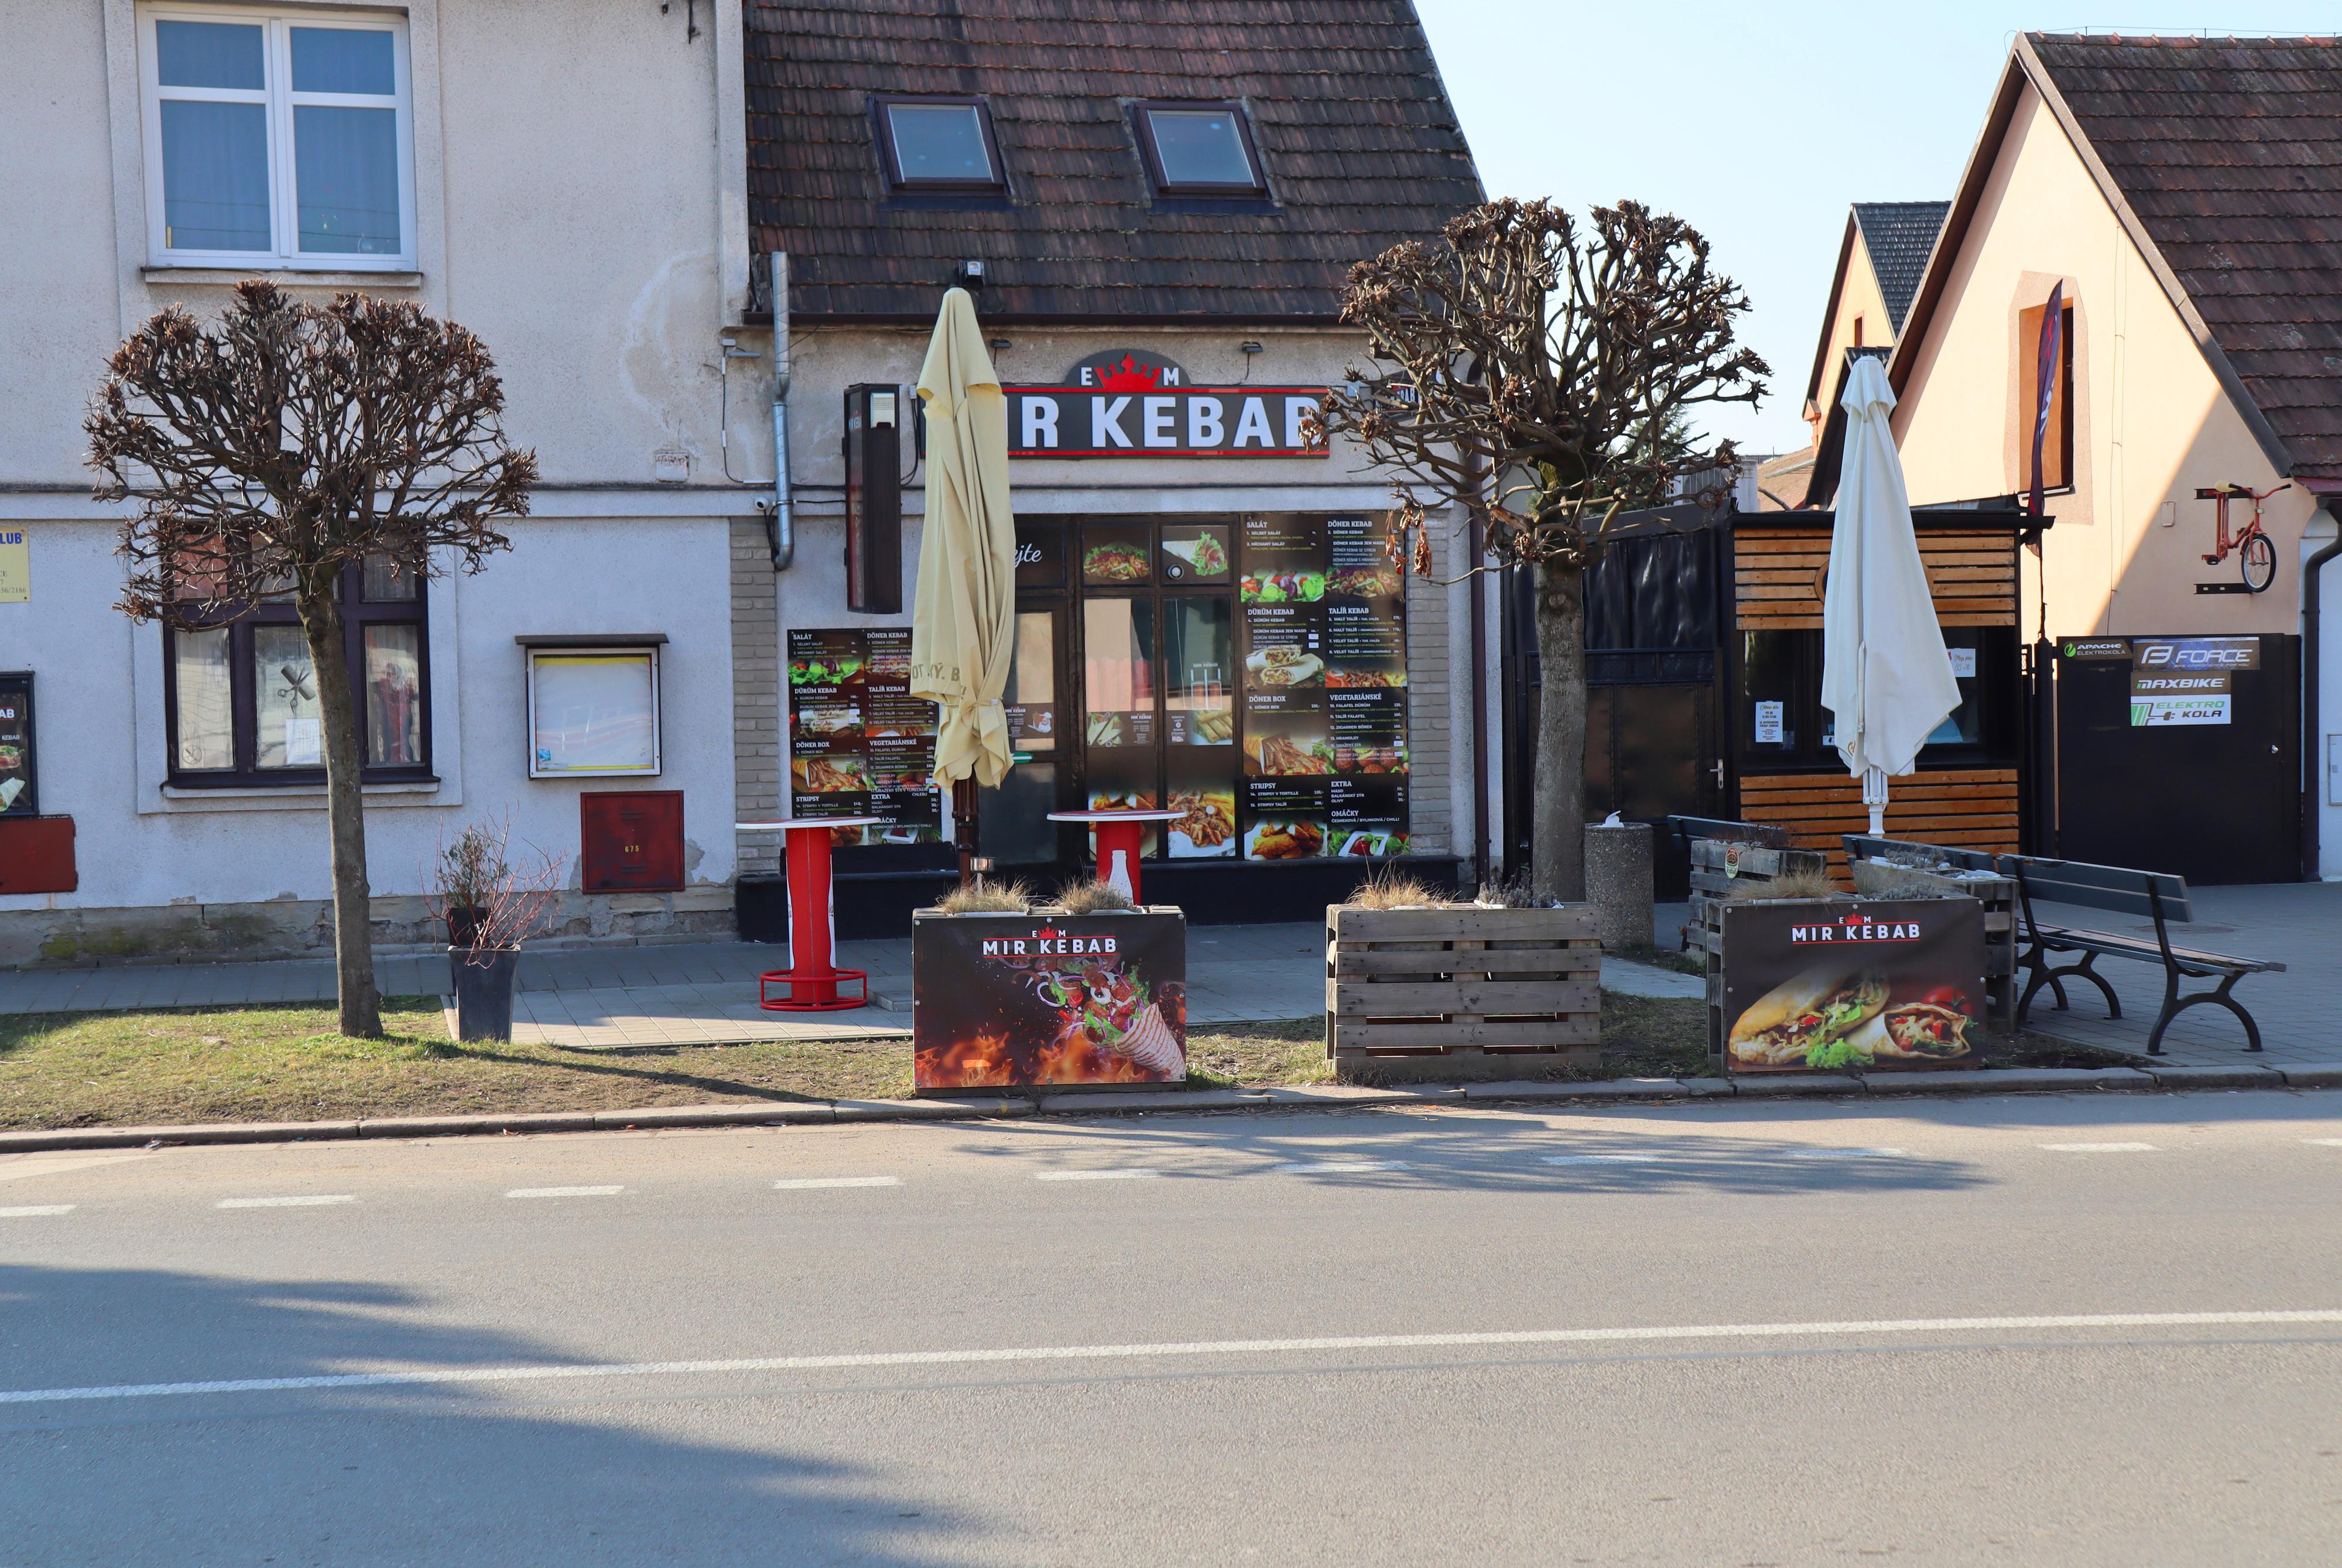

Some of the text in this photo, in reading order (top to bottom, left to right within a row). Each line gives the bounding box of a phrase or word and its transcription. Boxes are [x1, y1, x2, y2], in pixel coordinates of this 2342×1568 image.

[1091, 396, 1321, 447] KEBAB
[2176, 649, 2253, 663] FORCE
[2137, 678, 2225, 689] MAXBIKE
[2156, 701, 2225, 709] ELEKTRO
[625, 845, 639, 853] 675
[1792, 924, 1920, 942] MIR KEBAB
[982, 938, 1117, 956] MIR KEBAB
